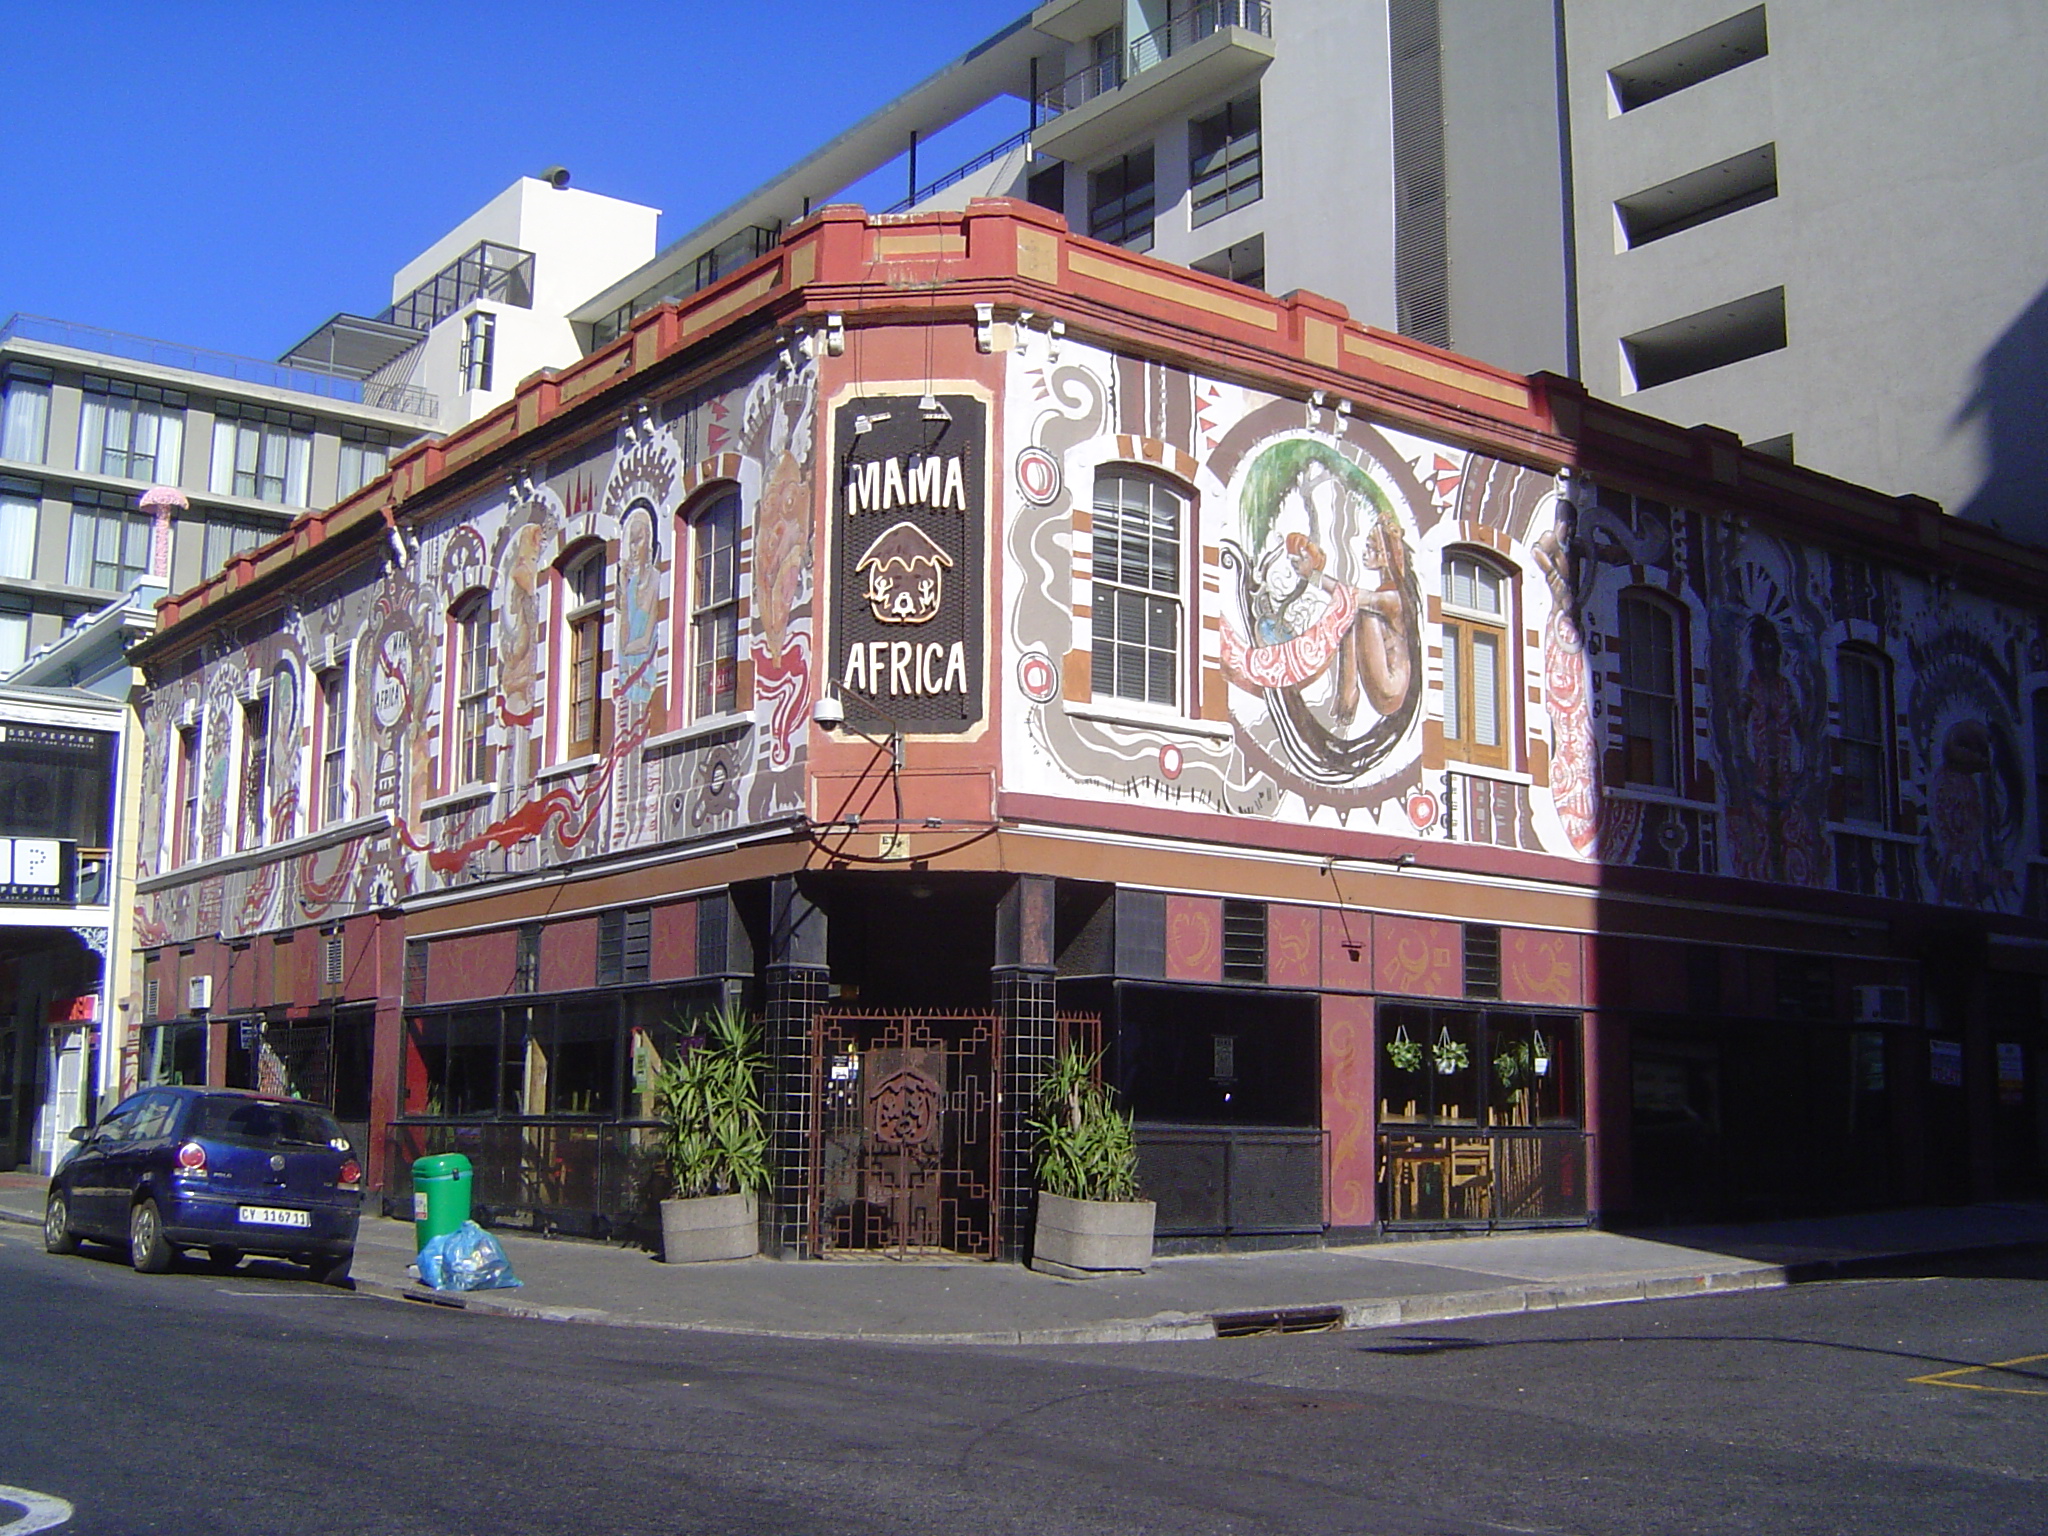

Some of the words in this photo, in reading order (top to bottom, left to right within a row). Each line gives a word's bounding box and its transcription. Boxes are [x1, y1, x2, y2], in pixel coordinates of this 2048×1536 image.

[848, 456, 966, 515] MAMA
[843, 640, 968, 695] AFRICA
[376, 684, 401, 711] AFRICA
[41, 731, 94, 743] PEPPER
[0, 886, 60, 895] PEPPER
[242, 1208, 256, 1220] CY
[264, 1209, 305, 1225] 116711
